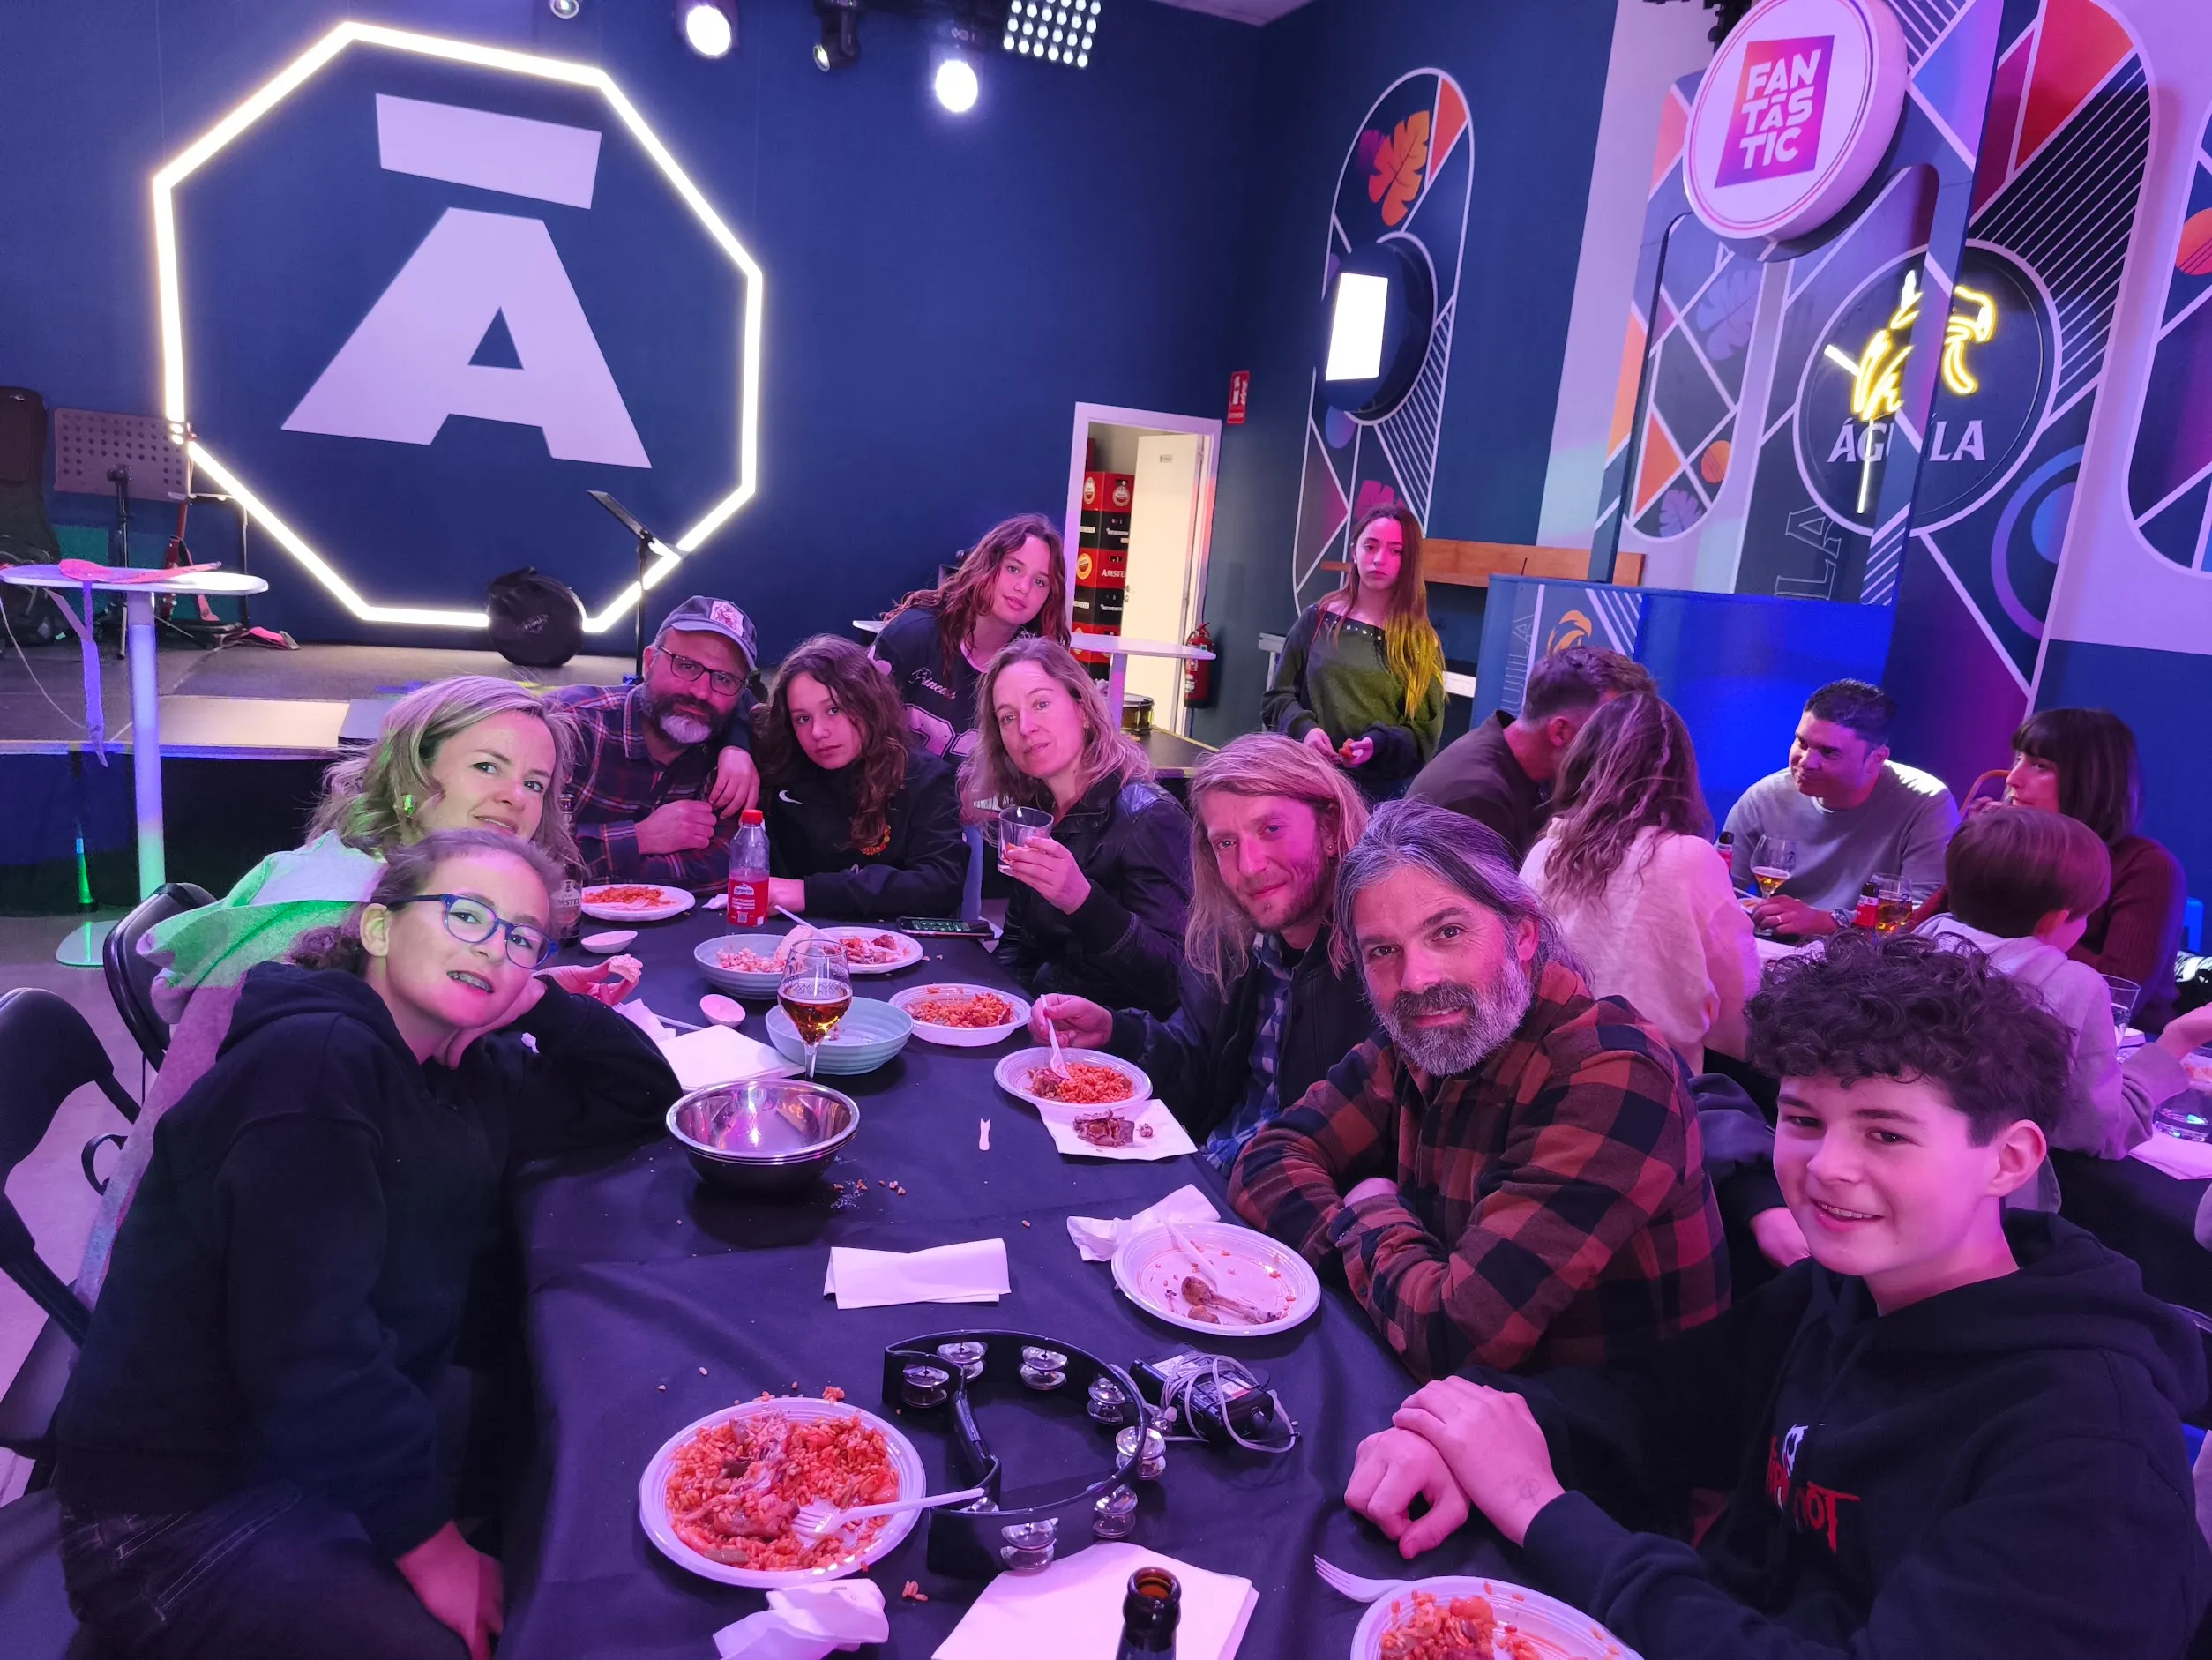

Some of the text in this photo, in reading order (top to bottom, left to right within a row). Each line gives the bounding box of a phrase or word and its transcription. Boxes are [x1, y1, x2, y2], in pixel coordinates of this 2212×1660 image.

[1745, 49, 1822, 101] FAN
[1739, 126, 1802, 170] TIC
[1827, 416, 1986, 463] ÁGLA
[1101, 568, 1126, 579] AMSTE
